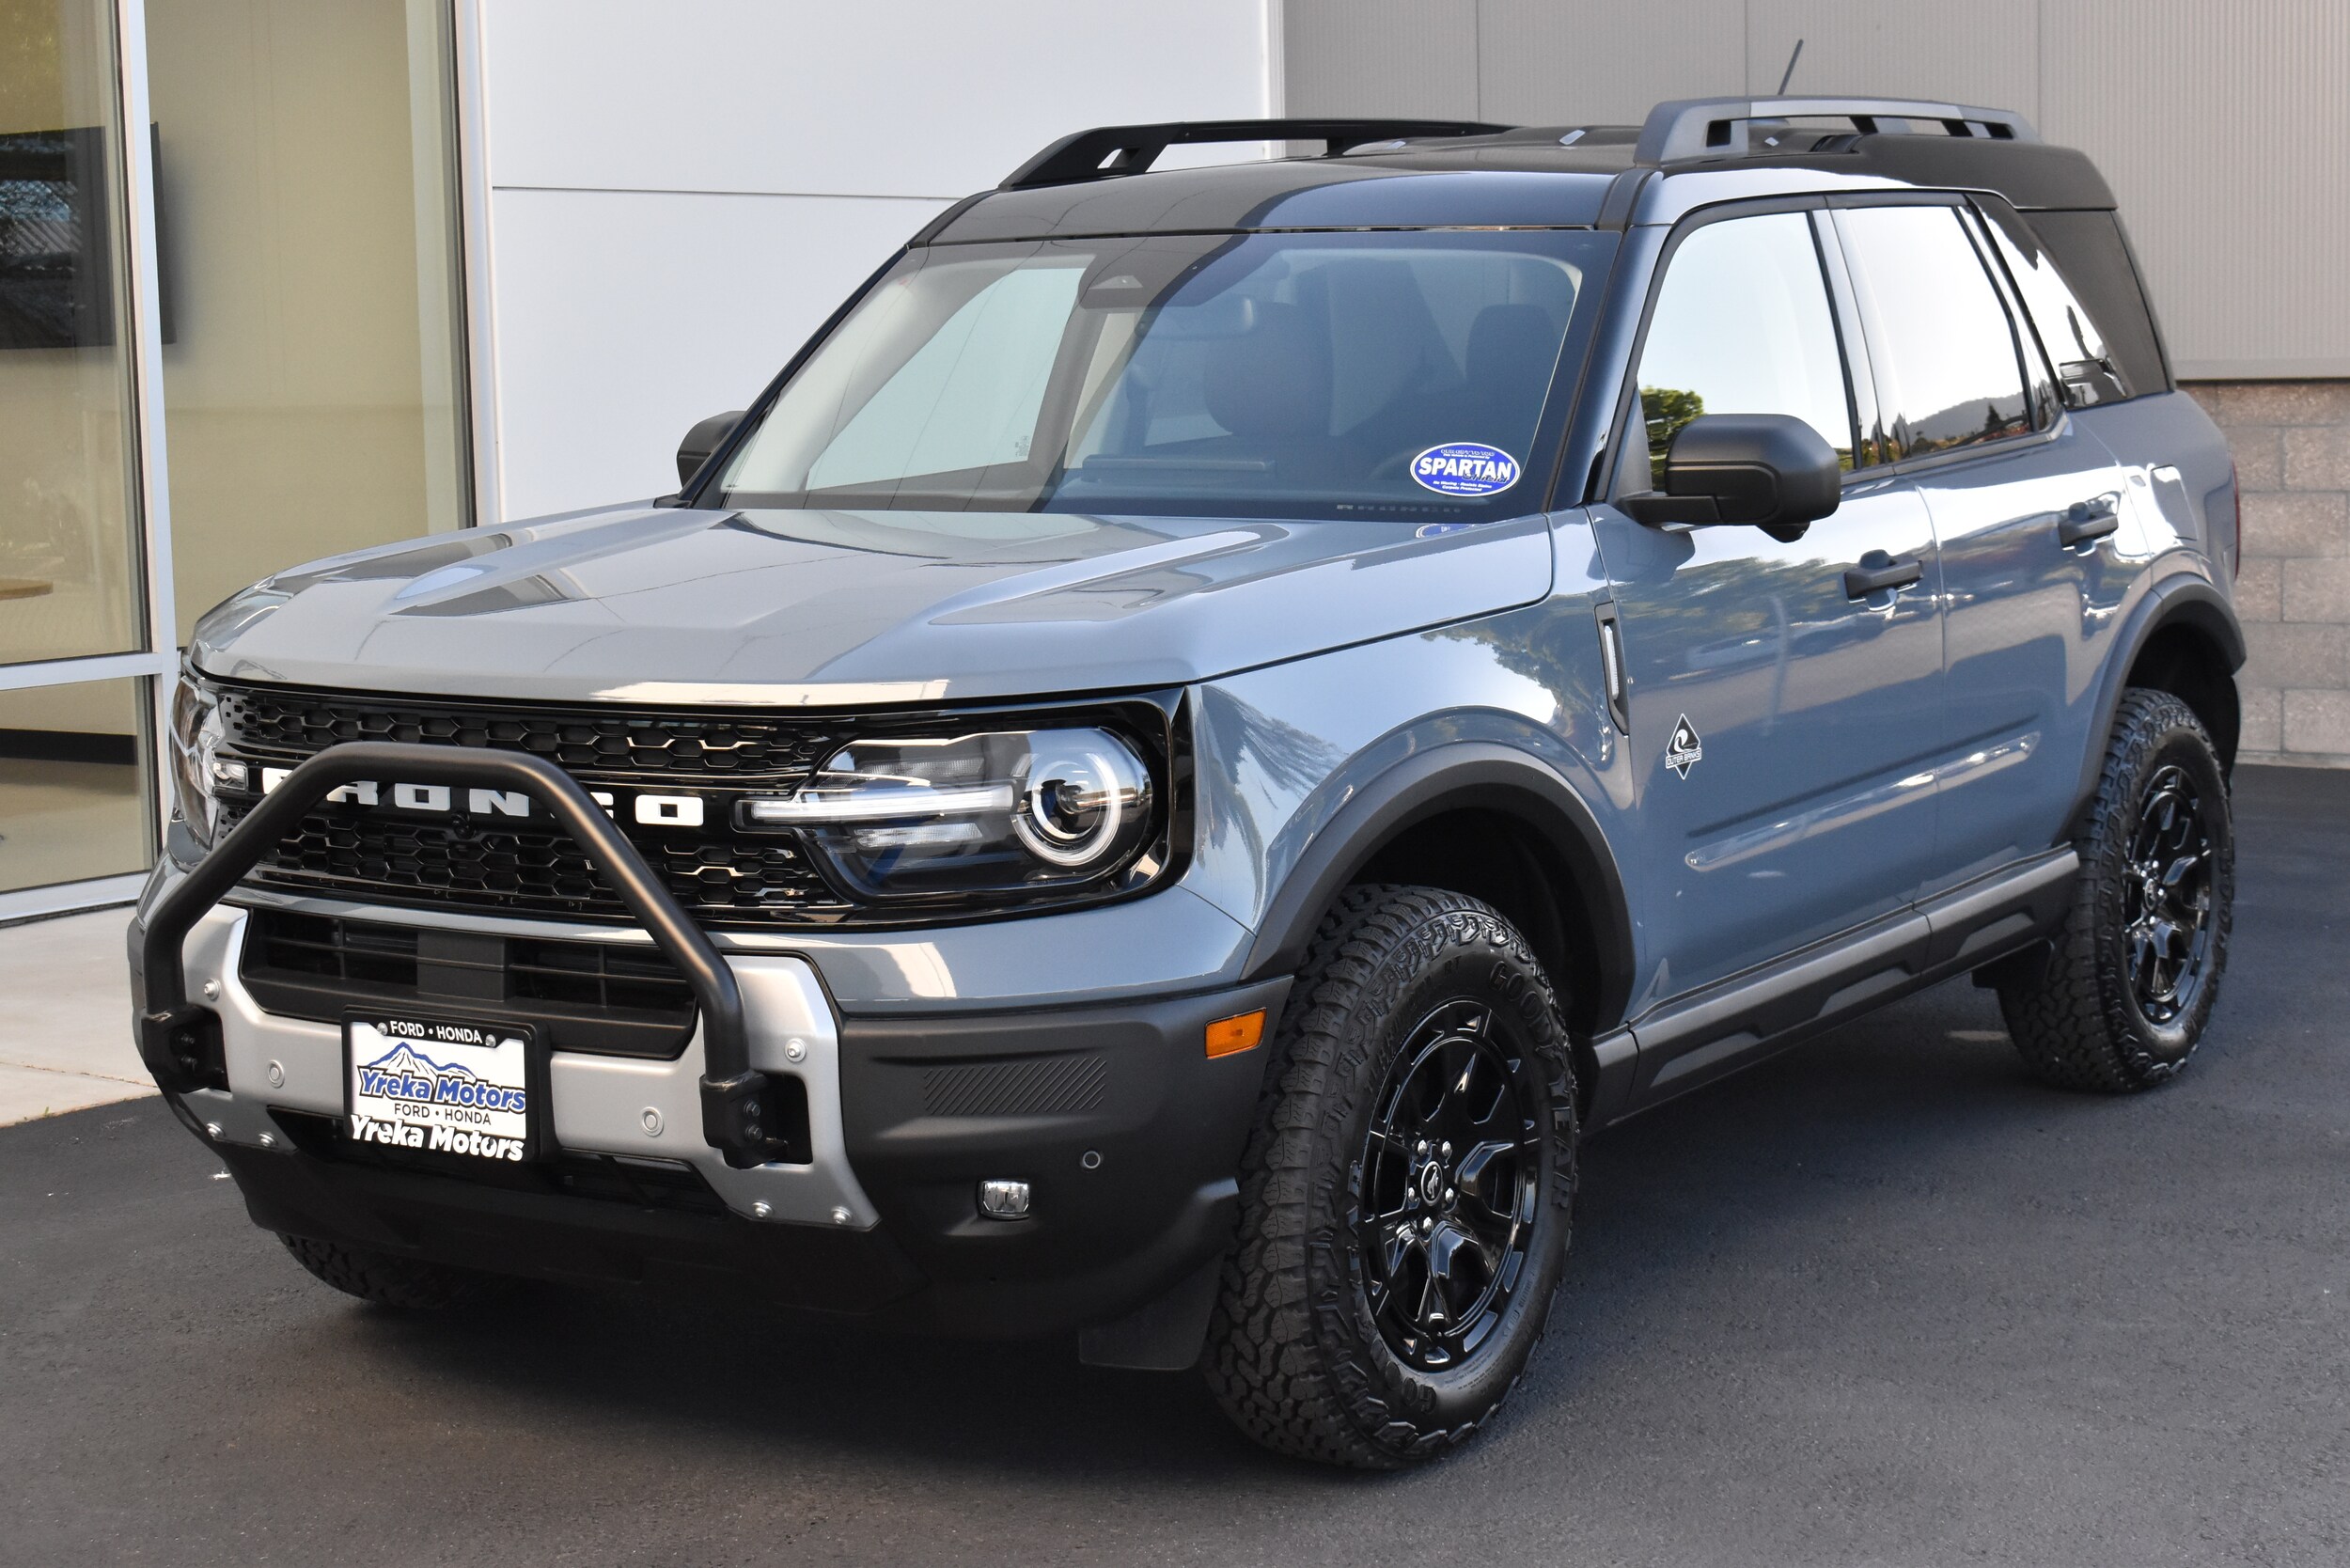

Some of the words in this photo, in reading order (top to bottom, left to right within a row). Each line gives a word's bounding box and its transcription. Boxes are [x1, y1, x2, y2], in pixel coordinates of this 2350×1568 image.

[1418, 457, 1512, 481] SPARTAN
[390, 1020, 425, 1036] FORD
[436, 1026, 483, 1044] HONDA
[358, 1066, 432, 1100] Yreka
[435, 1075, 526, 1113] Motors
[1490, 960, 1572, 1209] GOODYEAR
[394, 1103, 431, 1119] FORD
[445, 1108, 492, 1125] HONDA
[350, 1114, 425, 1148] Yreka
[429, 1124, 525, 1162] Motors
